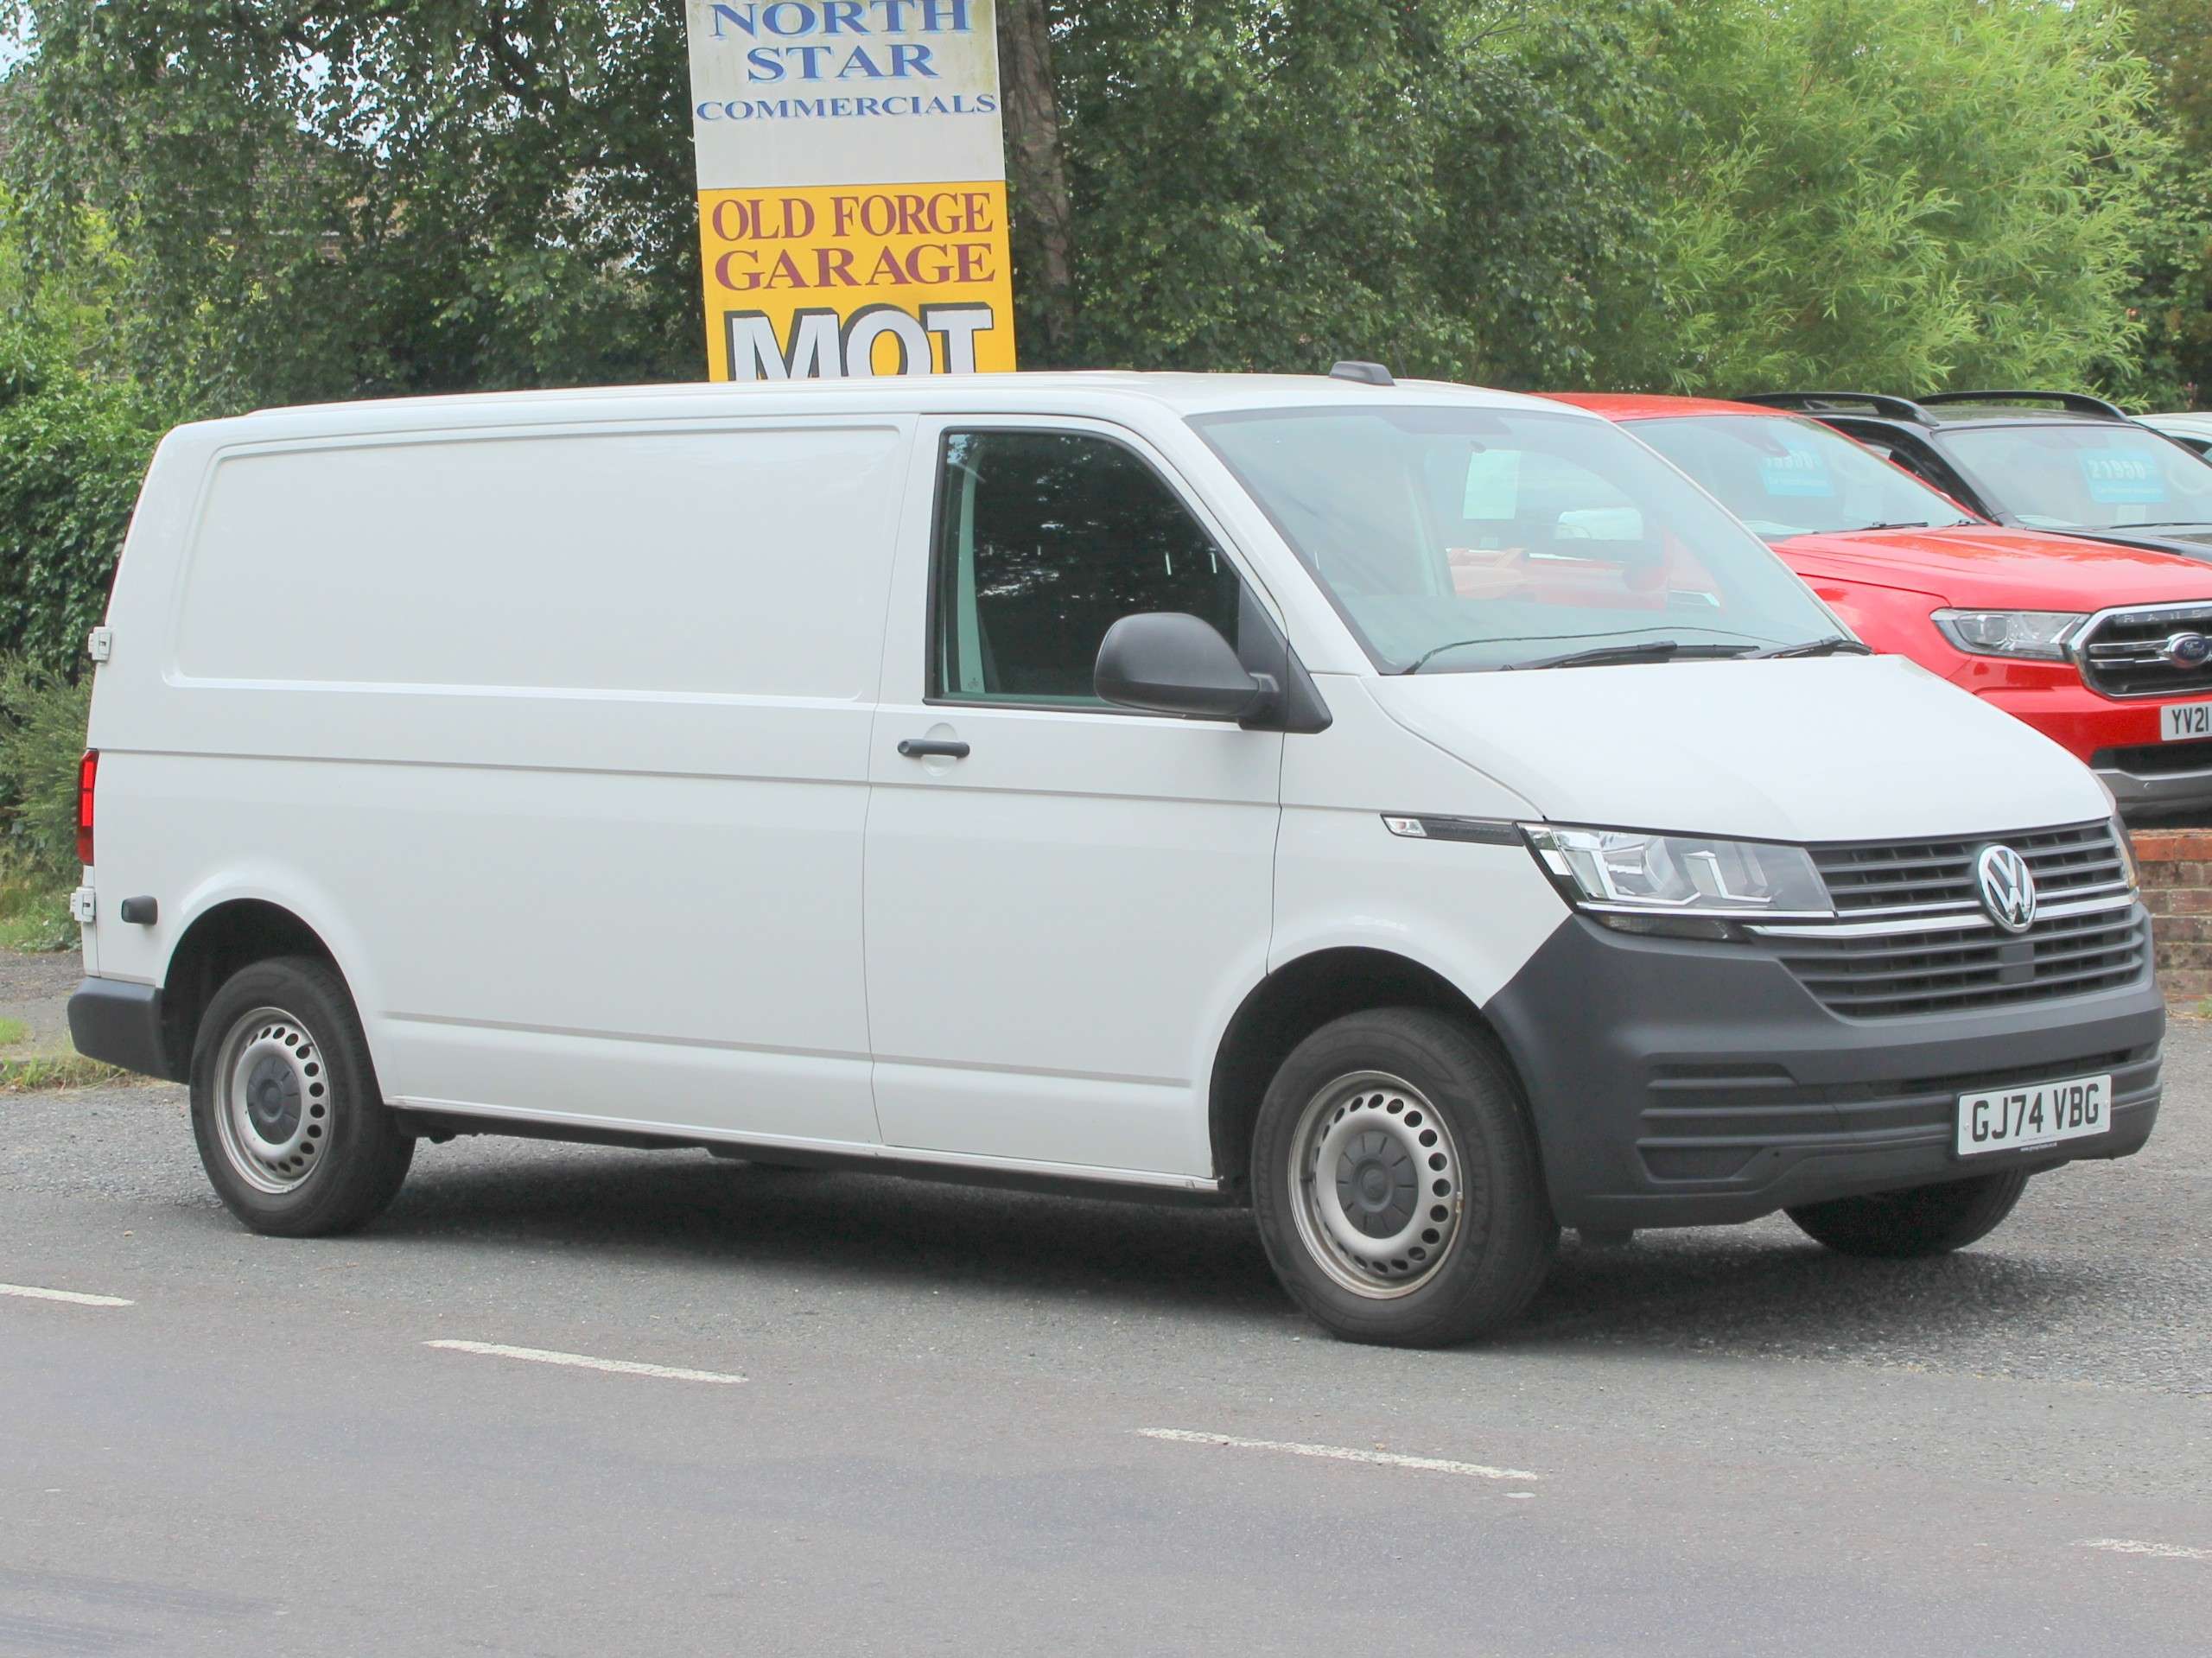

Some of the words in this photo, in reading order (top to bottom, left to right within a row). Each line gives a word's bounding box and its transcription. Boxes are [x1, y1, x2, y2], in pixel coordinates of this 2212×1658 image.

[711, 0, 972, 39] NORTH
[747, 44, 942, 82] STAR
[696, 94, 997, 121] COMMERCIALS
[712, 198, 815, 242] OLD
[830, 192, 994, 238] FORGE
[715, 243, 995, 291] GARAGE
[723, 302, 995, 381] MOT
[2171, 706, 2209, 734] YV21
[1972, 1092, 2044, 1142] GJ74
[2054, 1083, 2099, 1130] VBG
